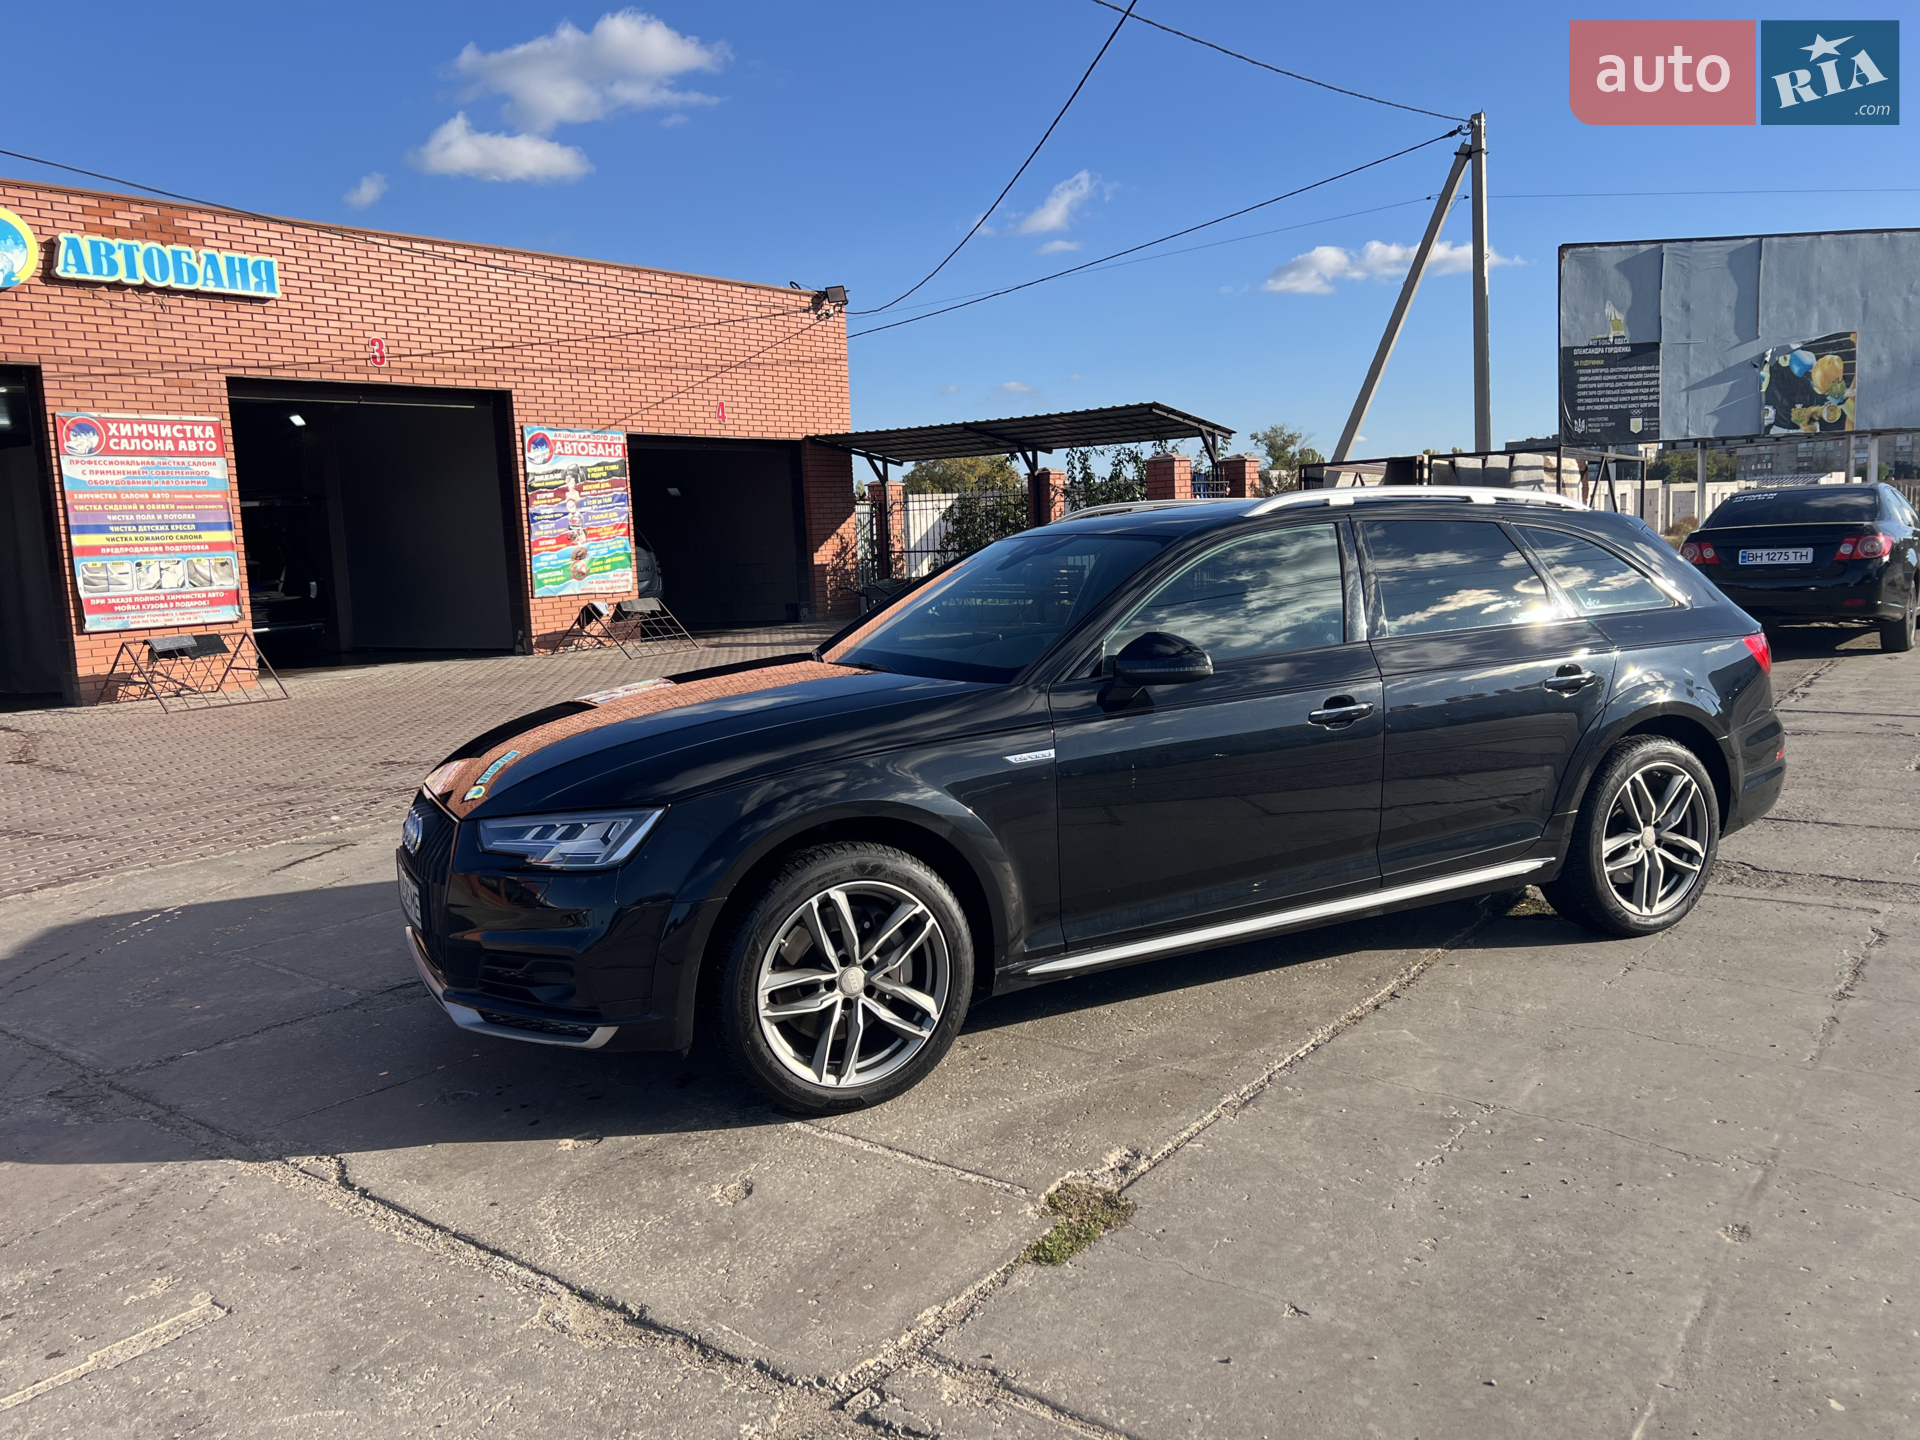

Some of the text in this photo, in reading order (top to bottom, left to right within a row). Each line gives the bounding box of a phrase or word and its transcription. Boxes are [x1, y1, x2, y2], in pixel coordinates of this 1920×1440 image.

[58, 234, 280, 296] АВТОБАНЯ
[369, 337, 387, 367] 3
[715, 400, 728, 425] 4
[106, 422, 216, 439] ХИМЧИСТКА
[578, 433, 608, 441] КАЖДОГО
[109, 438, 217, 452] САЛОНА АВТО
[554, 440, 623, 457] АВТОБАНЯ
[69, 459, 155, 467] ПРОФЕССИОНАЛЬНАЯ
[103, 503, 138, 511] СИДЕНИЙ
[101, 544, 209, 554] ПРЕДПРОДАЖНАЯ ПОДГОТОВКА
[1747, 551, 1809, 562] BH 1275 TH
[637, 565, 653, 573] UKI
[107, 596, 133, 604] ЗАКАЗЕ
[134, 594, 165, 603] ПОЛНОЙ
[166, 593, 207, 601] ХИМЧИСТКИ
[114, 603, 141, 612] МОЙКА
[141, 602, 169, 610] КУЗОВА
[175, 599, 210, 608] ПОДАРОК!
